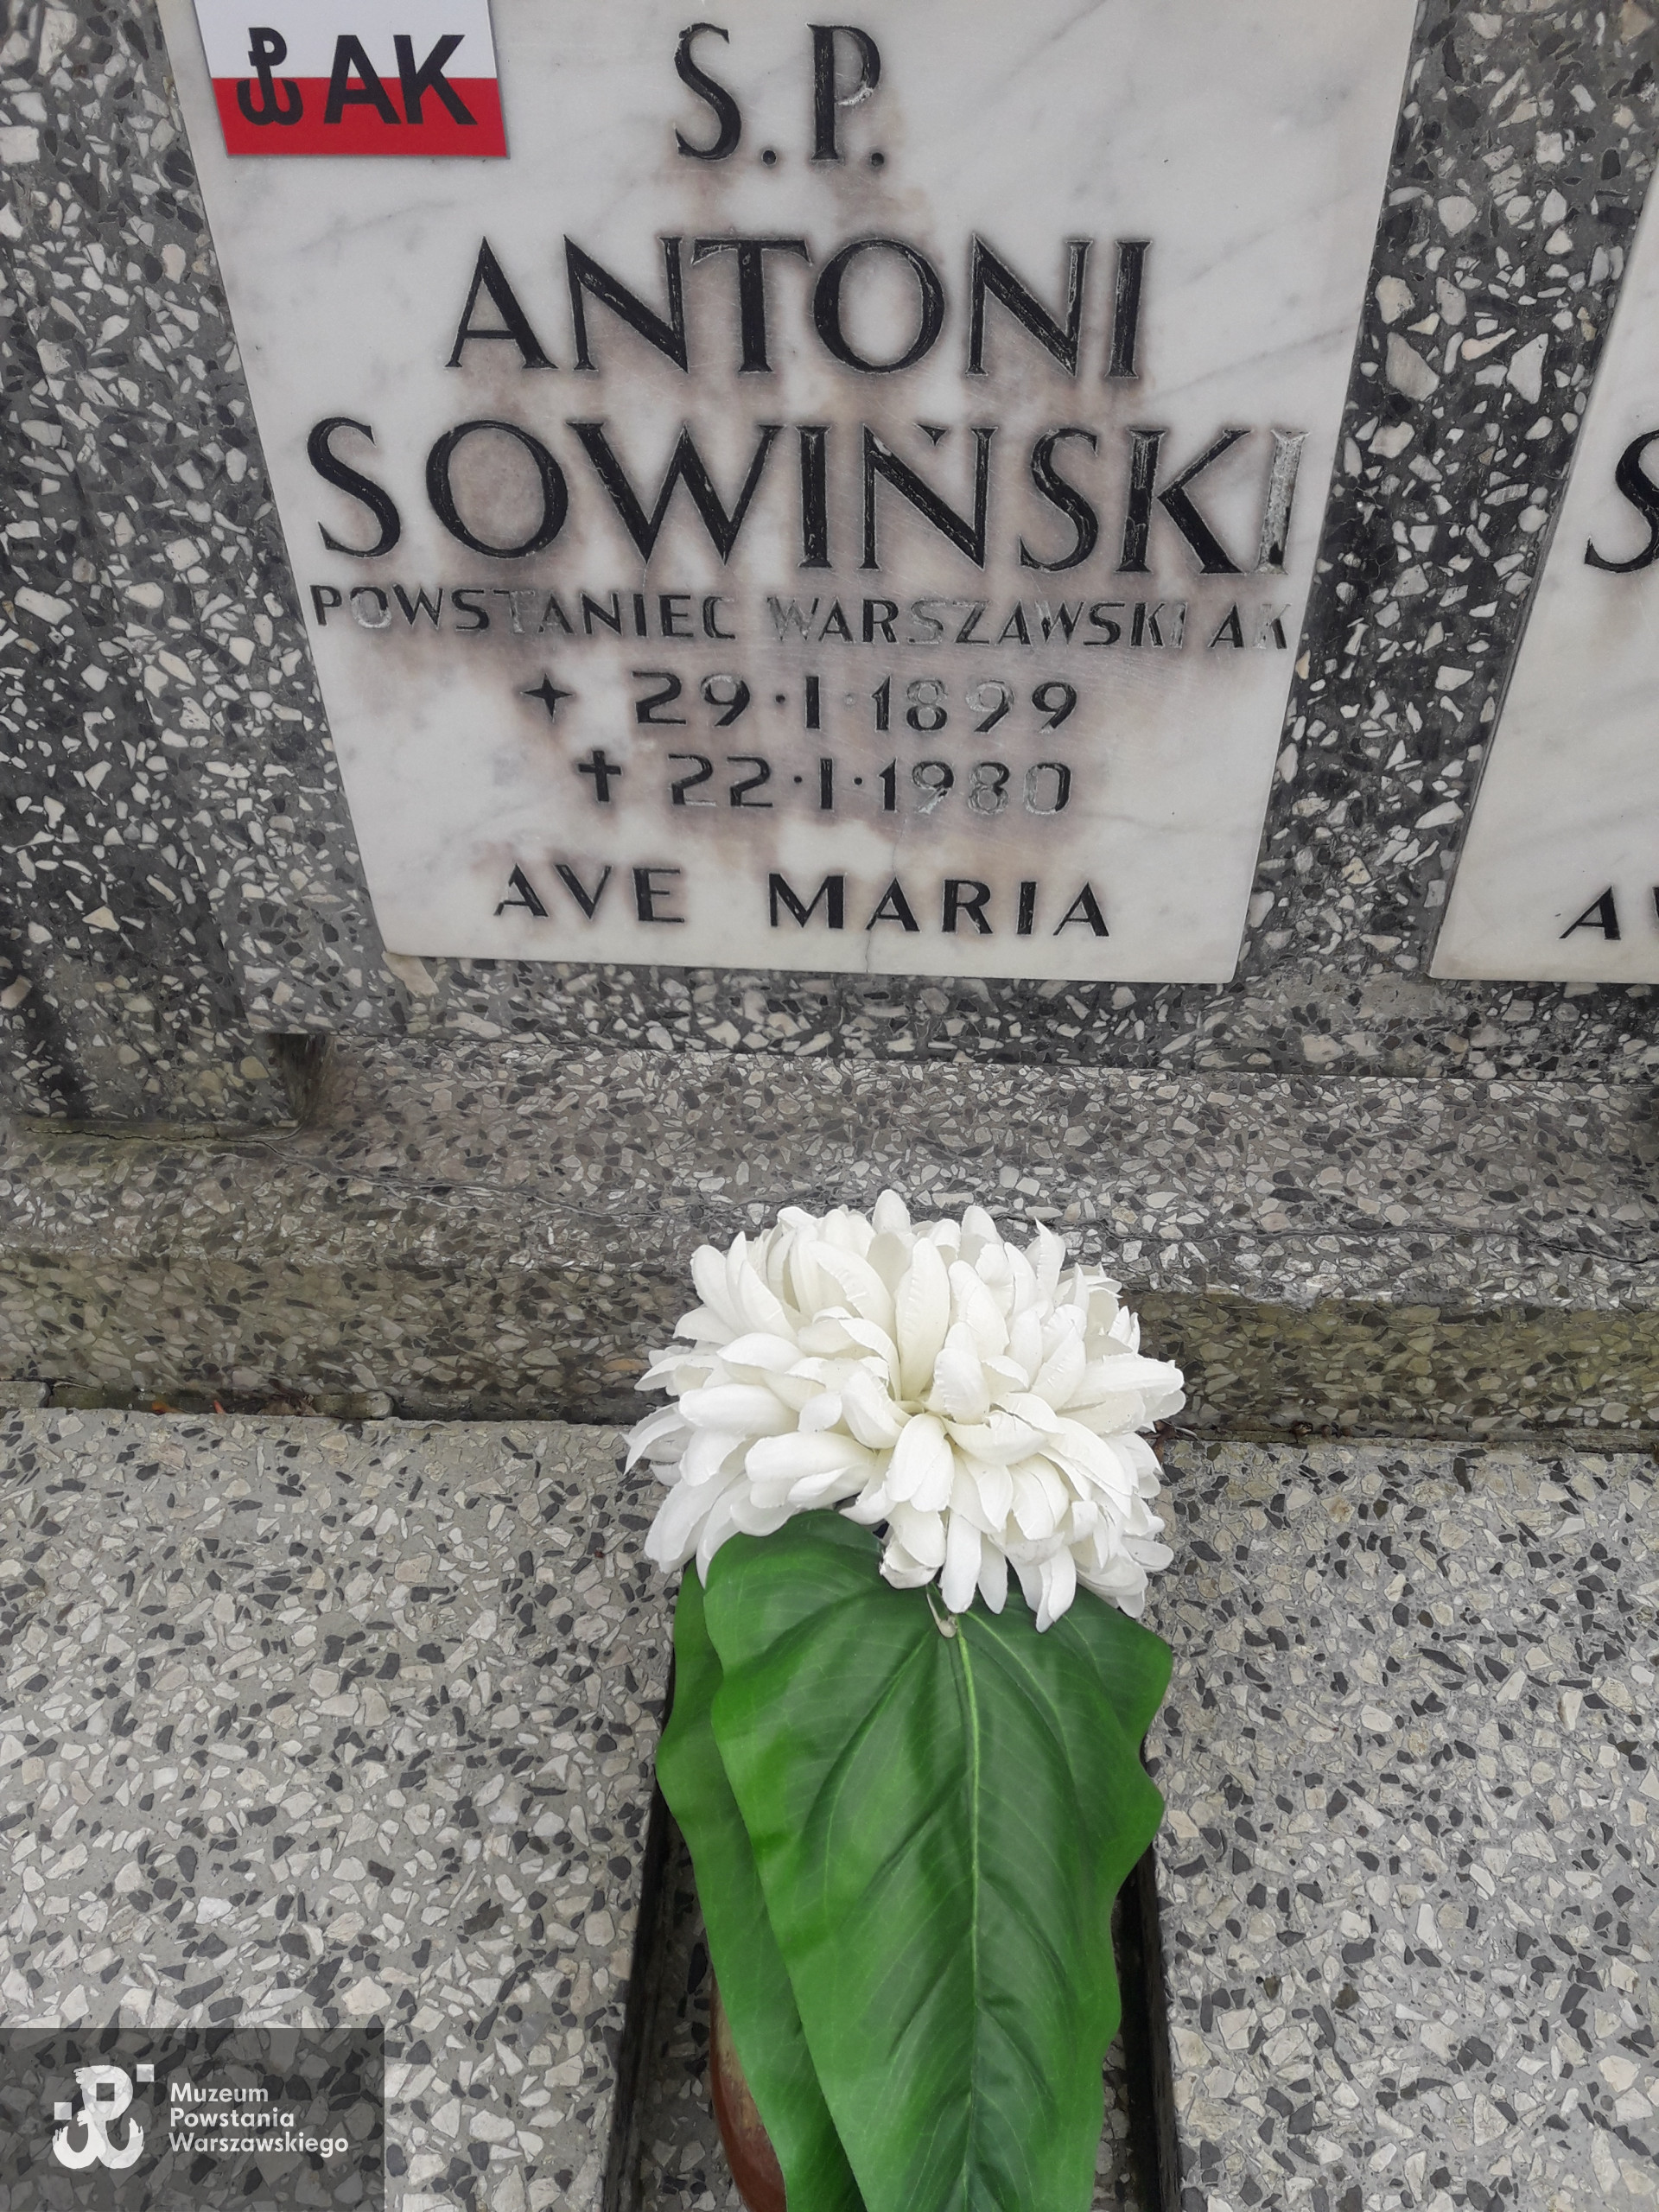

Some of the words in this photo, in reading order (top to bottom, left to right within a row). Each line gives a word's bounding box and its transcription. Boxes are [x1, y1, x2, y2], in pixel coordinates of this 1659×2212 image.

[323, 35, 478, 124] AK
[443, 234, 1153, 378] ANTONI
[309, 583, 736, 640] POWSTANIEC
[767, 595, 1187, 650] WARSZAWSKI
[1208, 601, 1292, 651] AK
[493, 864, 685, 924] AVE
[767, 871, 1111, 938] MARIA
